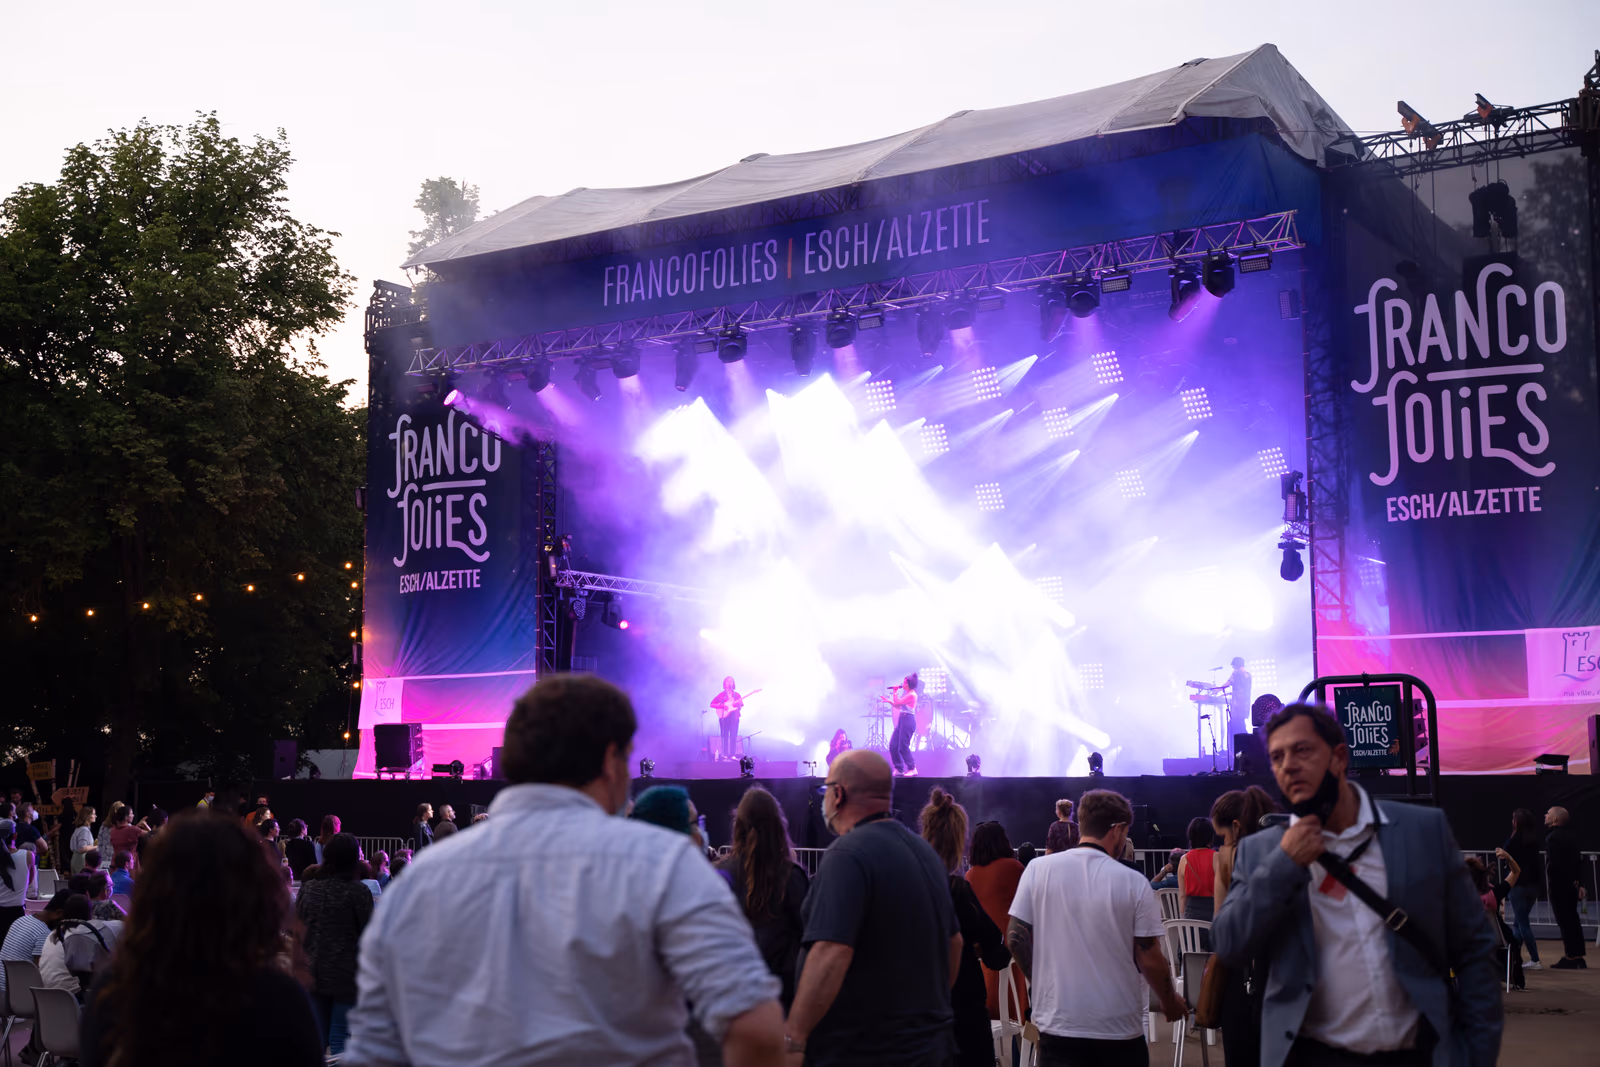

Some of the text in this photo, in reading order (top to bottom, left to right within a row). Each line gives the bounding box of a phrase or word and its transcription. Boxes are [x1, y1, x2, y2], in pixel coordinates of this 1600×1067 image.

[603, 239, 778, 306] FRANCOFOLIES
[804, 199, 990, 275] ESCH/ALZETTE
[1386, 486, 1542, 522] ESCH/ALZETTE
[400, 569, 481, 594] ESCH/ALZETTE
[380, 698, 395, 709] ESCH
